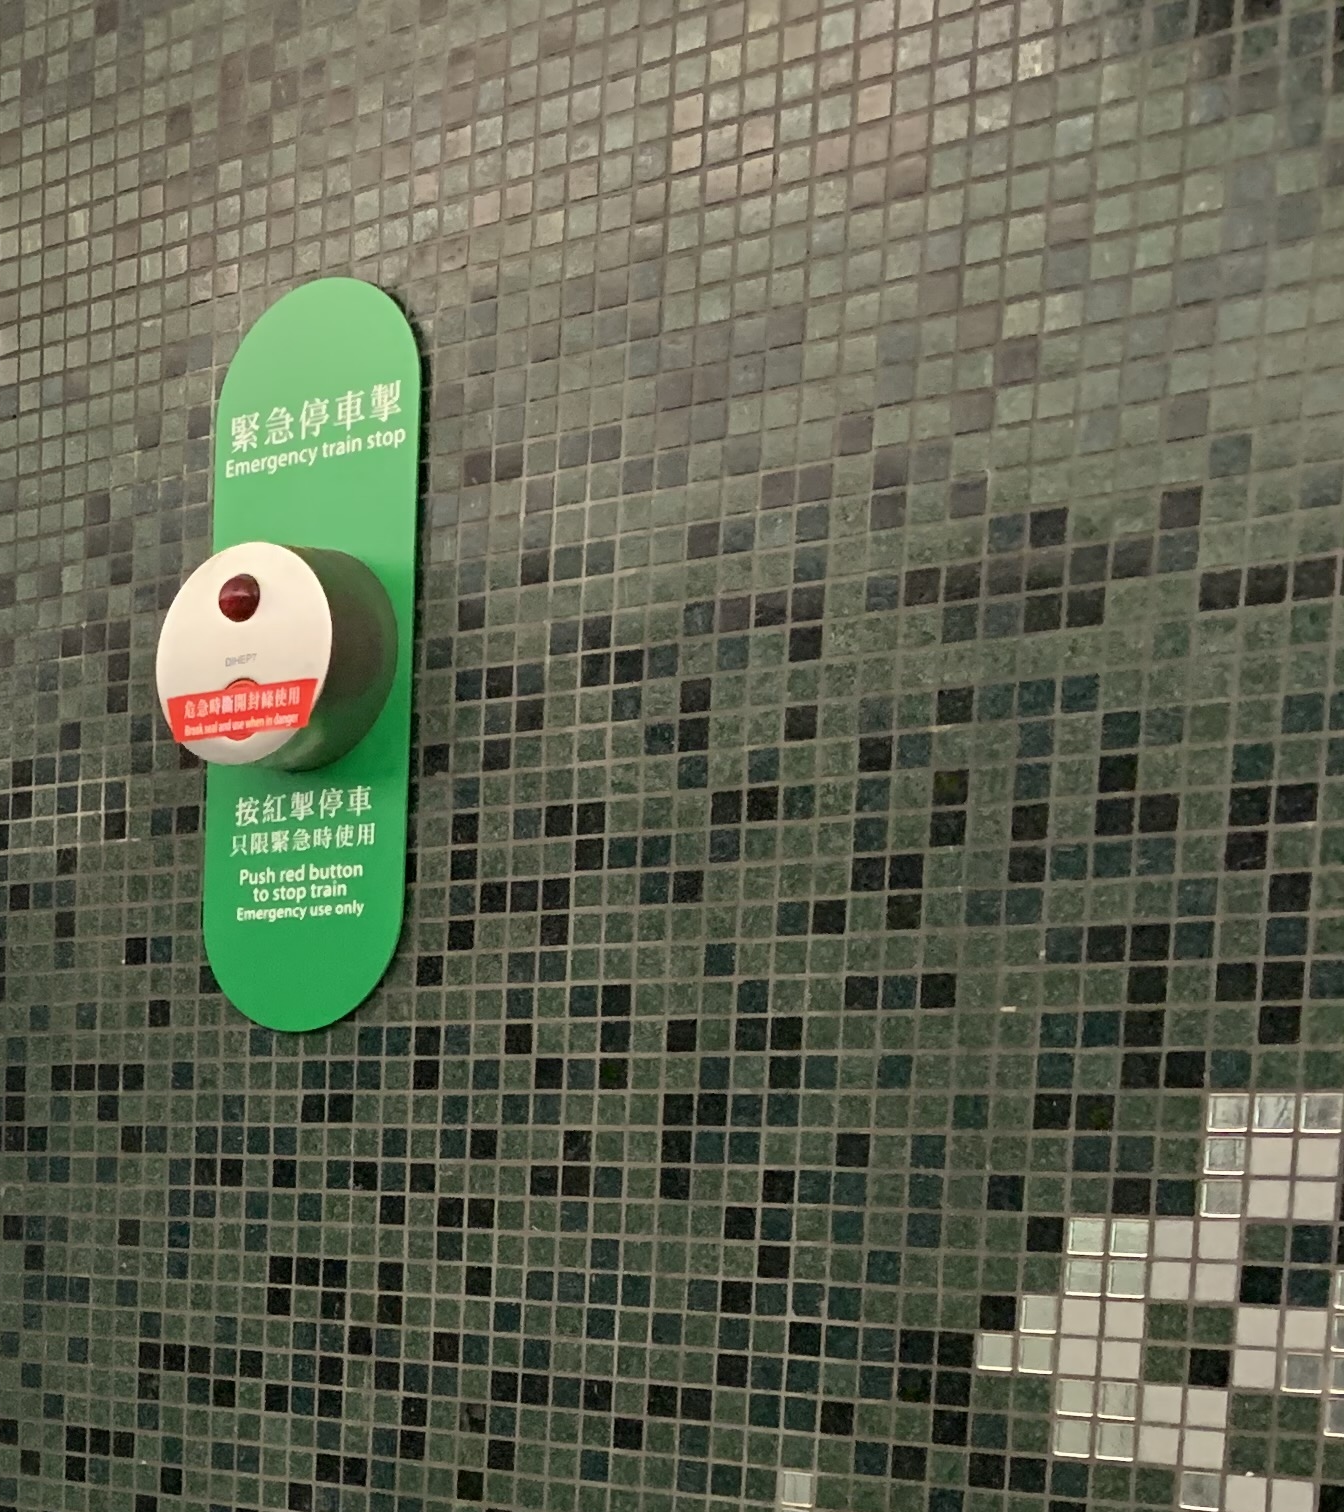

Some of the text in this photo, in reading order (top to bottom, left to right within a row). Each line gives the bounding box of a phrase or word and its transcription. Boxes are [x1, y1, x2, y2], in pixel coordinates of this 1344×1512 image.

[231, 380, 402, 454] 緊急停車掣
[225, 428, 406, 478] Emergency train stop
[235, 785, 373, 828] 按紅掣停車
[229, 822, 376, 858] 只限緊急時使用
[239, 863, 364, 886] Push red button
[253, 880, 347, 903] to stop train
[236, 900, 365, 922] Emergency use only
